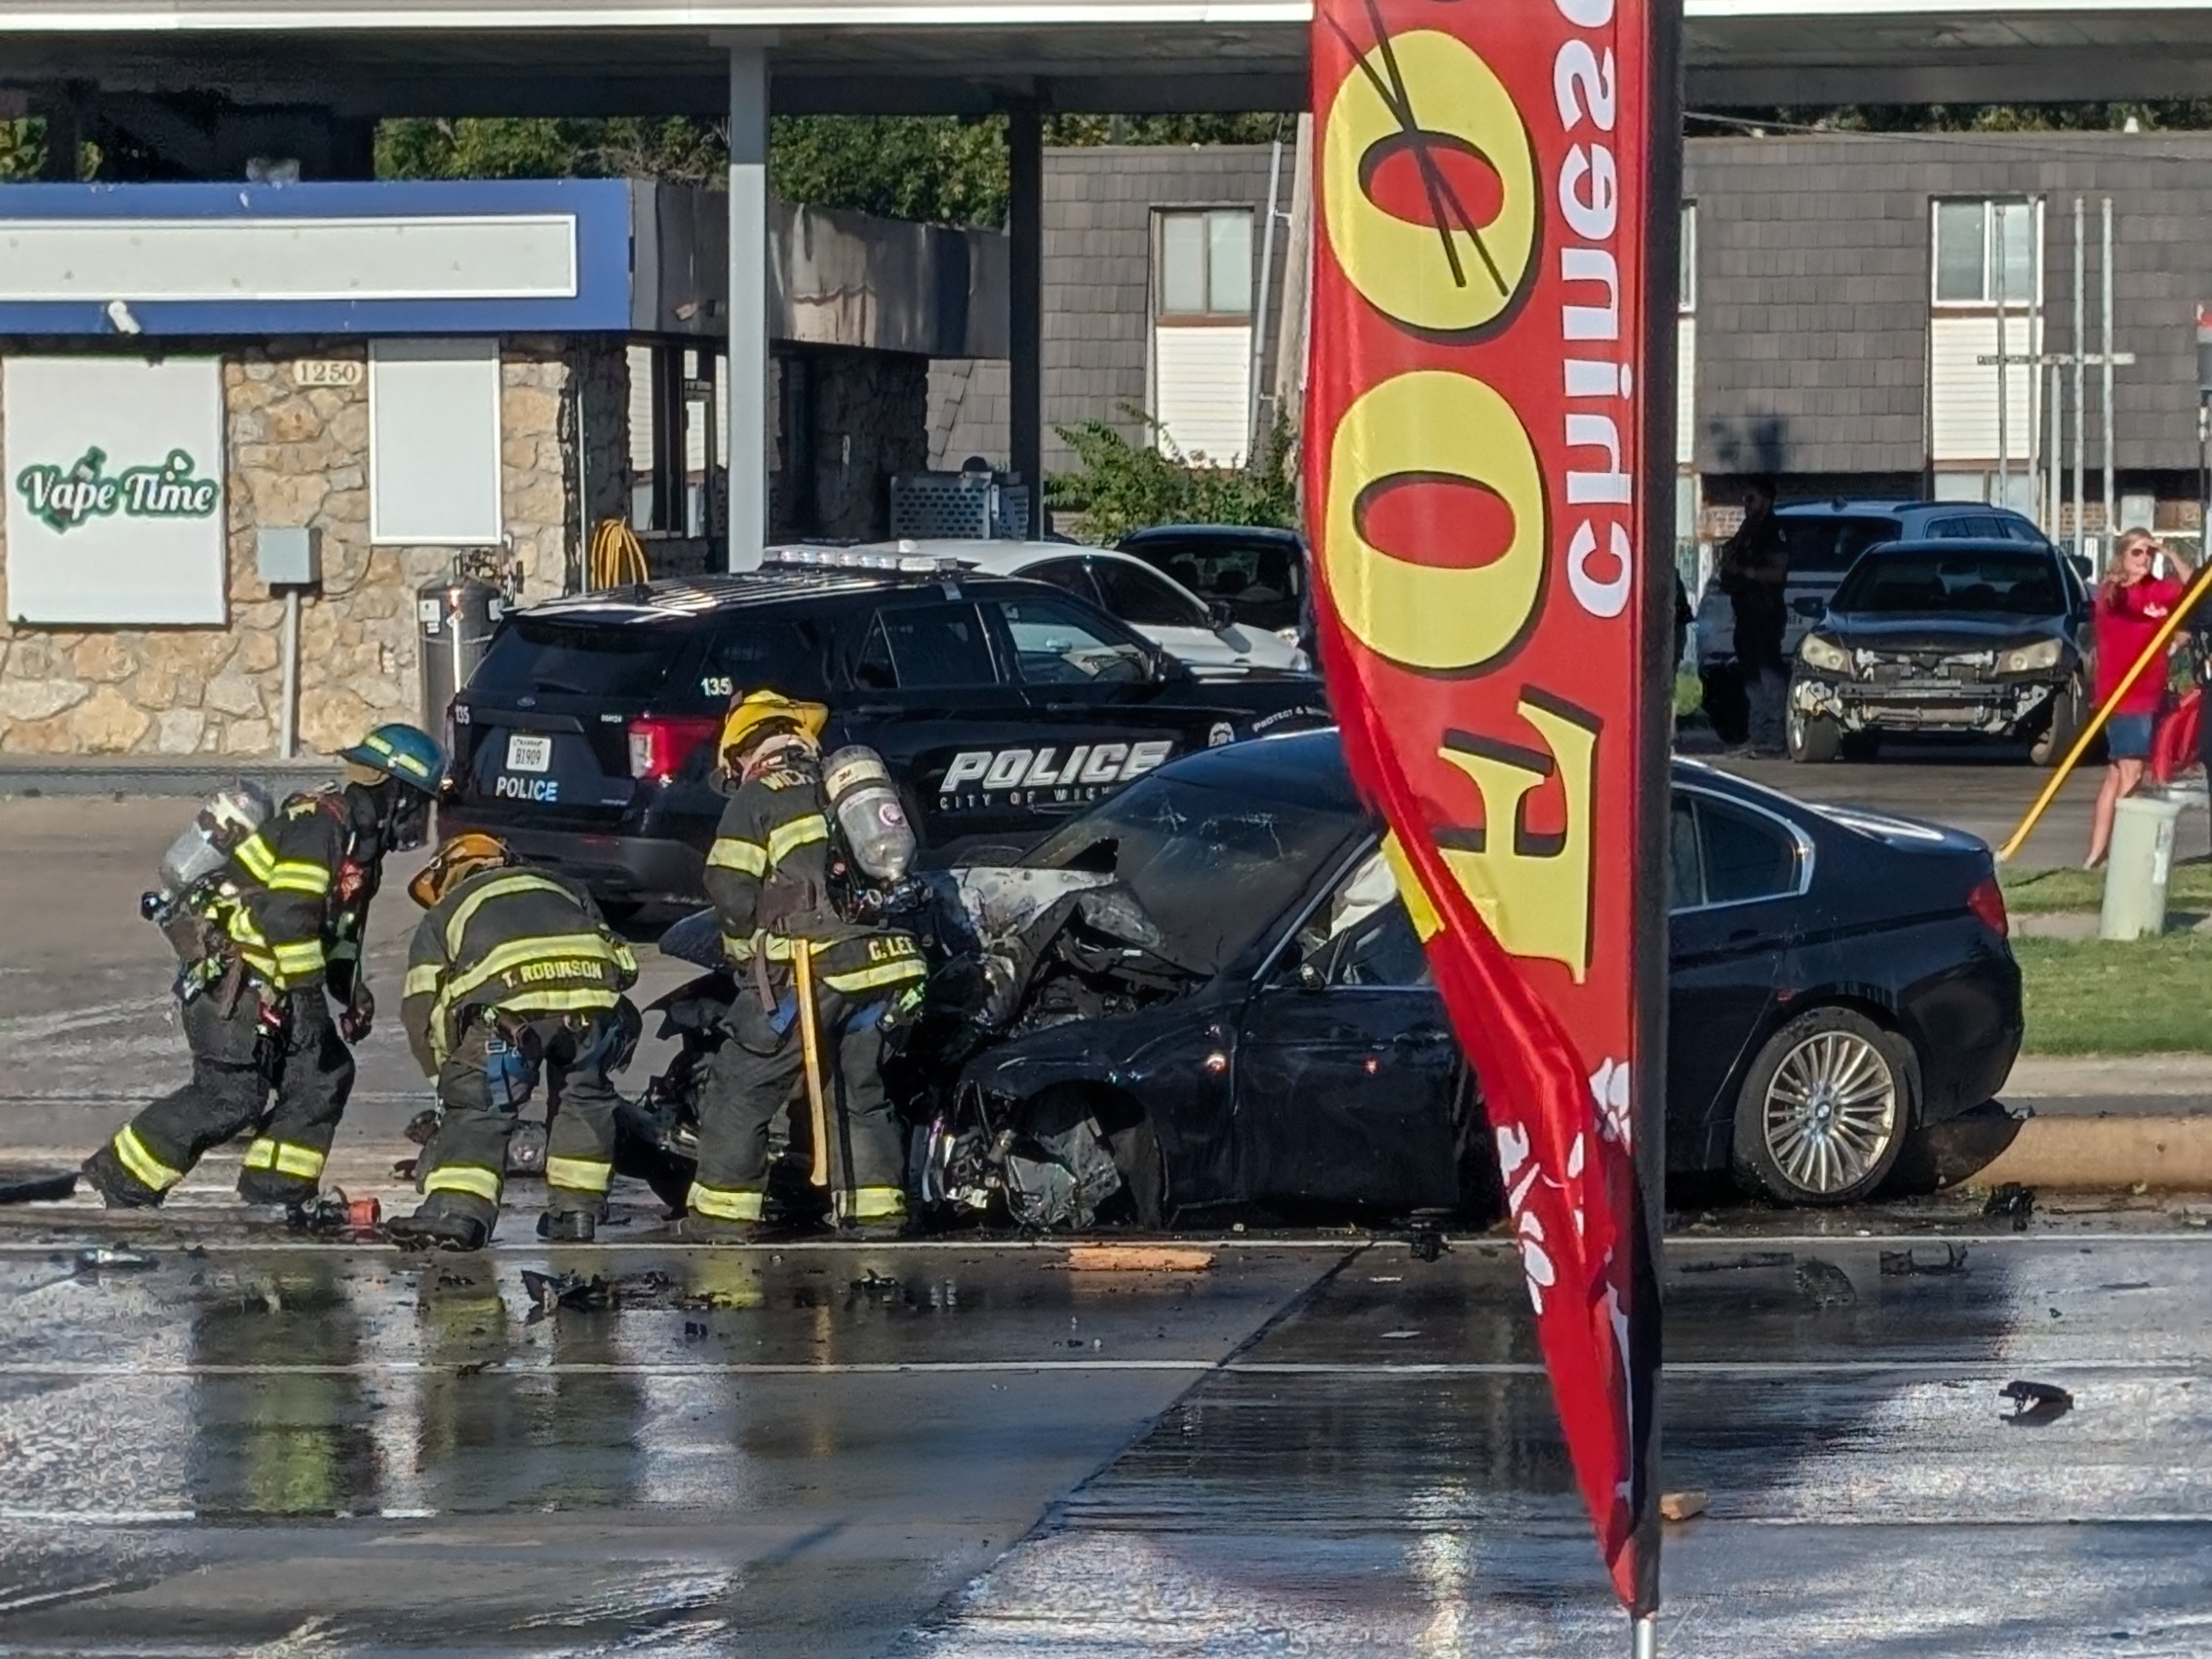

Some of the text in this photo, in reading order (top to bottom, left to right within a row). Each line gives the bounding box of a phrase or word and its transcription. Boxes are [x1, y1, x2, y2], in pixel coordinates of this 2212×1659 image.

[301, 363, 356, 382] 1250
[21, 469, 214, 521] Vape Time
[700, 677, 731, 697] 135
[454, 705, 470, 725] 135
[1251, 708, 1293, 732] PROTECT
[938, 740, 1173, 792] POLICE
[495, 776, 559, 803] POLICE
[939, 793, 991, 810] CITY
[1009, 791, 1037, 806] OF
[501, 960, 603, 989] T. ROBINSON
